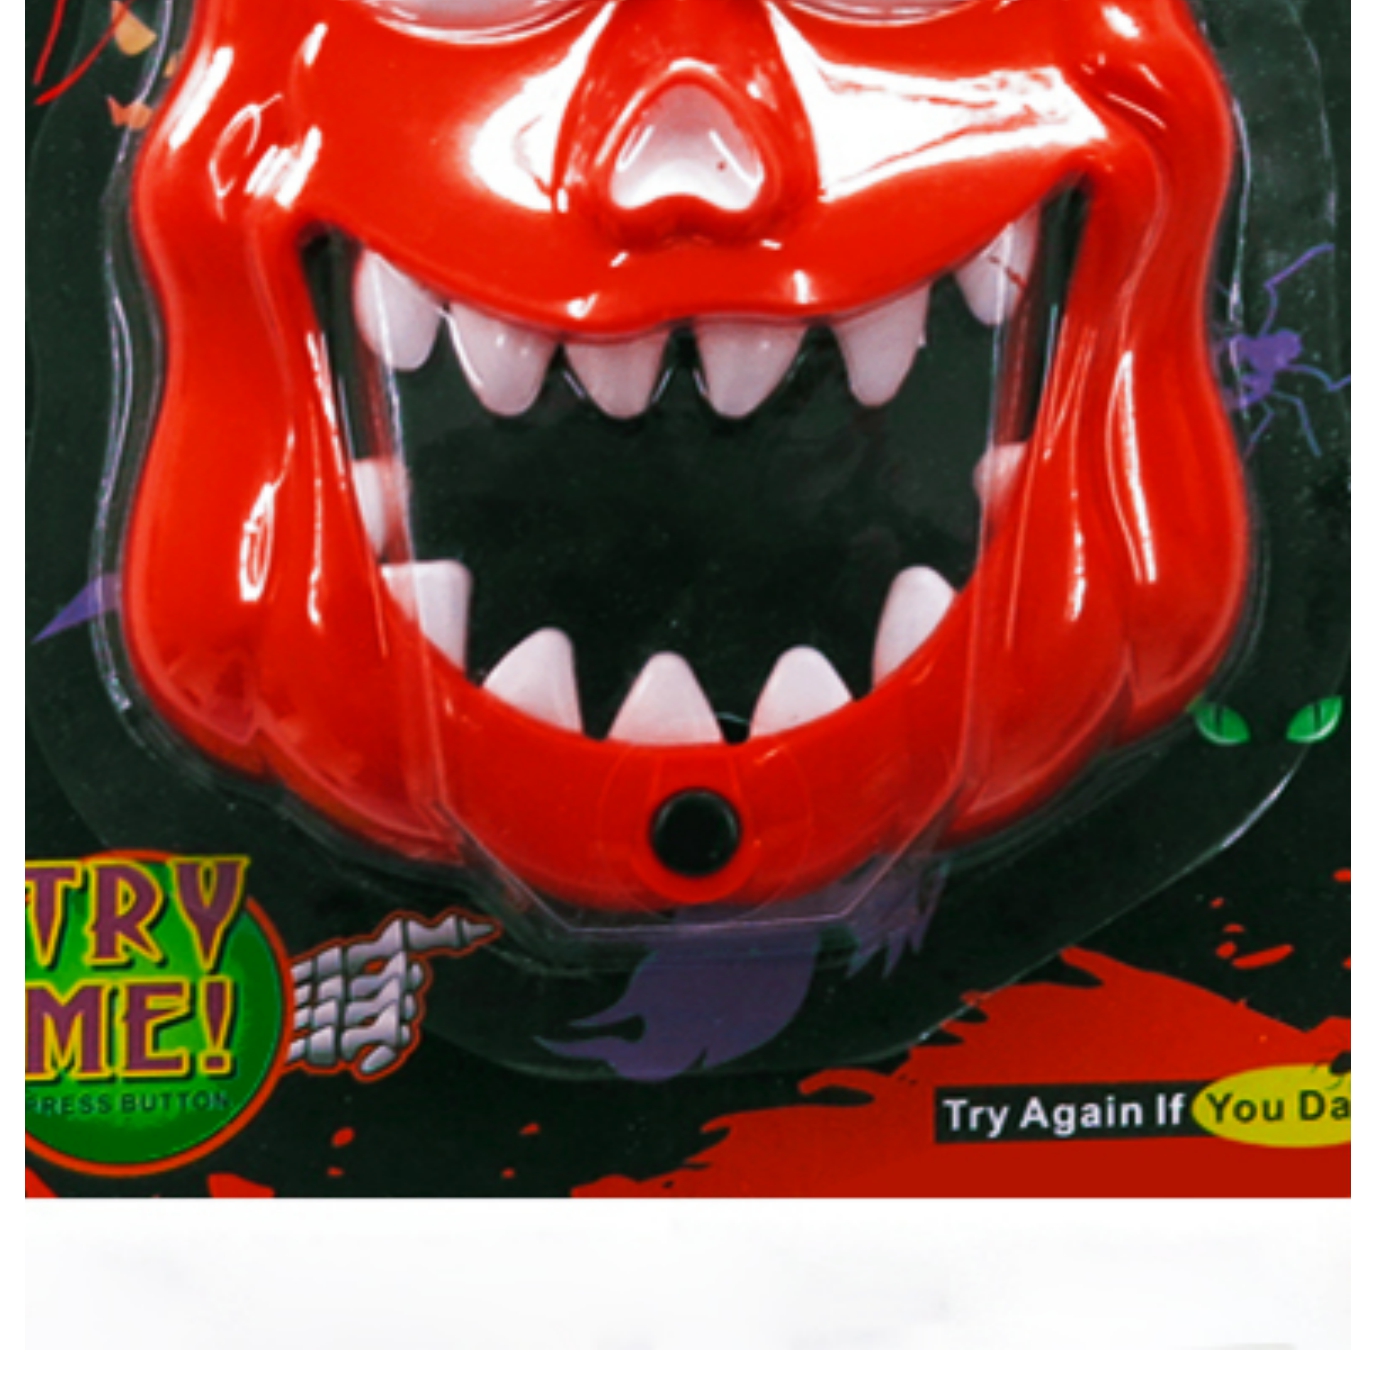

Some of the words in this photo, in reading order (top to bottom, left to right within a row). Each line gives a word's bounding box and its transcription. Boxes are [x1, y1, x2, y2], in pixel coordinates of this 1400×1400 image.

[25, 855, 250, 970] TRY
[25, 976, 232, 1080] ME!
[120, 1089, 230, 1113] BUTTON
[942, 1098, 1010, 1139] Try
[1019, 1095, 1144, 1137] Again
[1155, 1093, 1186, 1126] If
[1206, 1093, 1286, 1125] You
